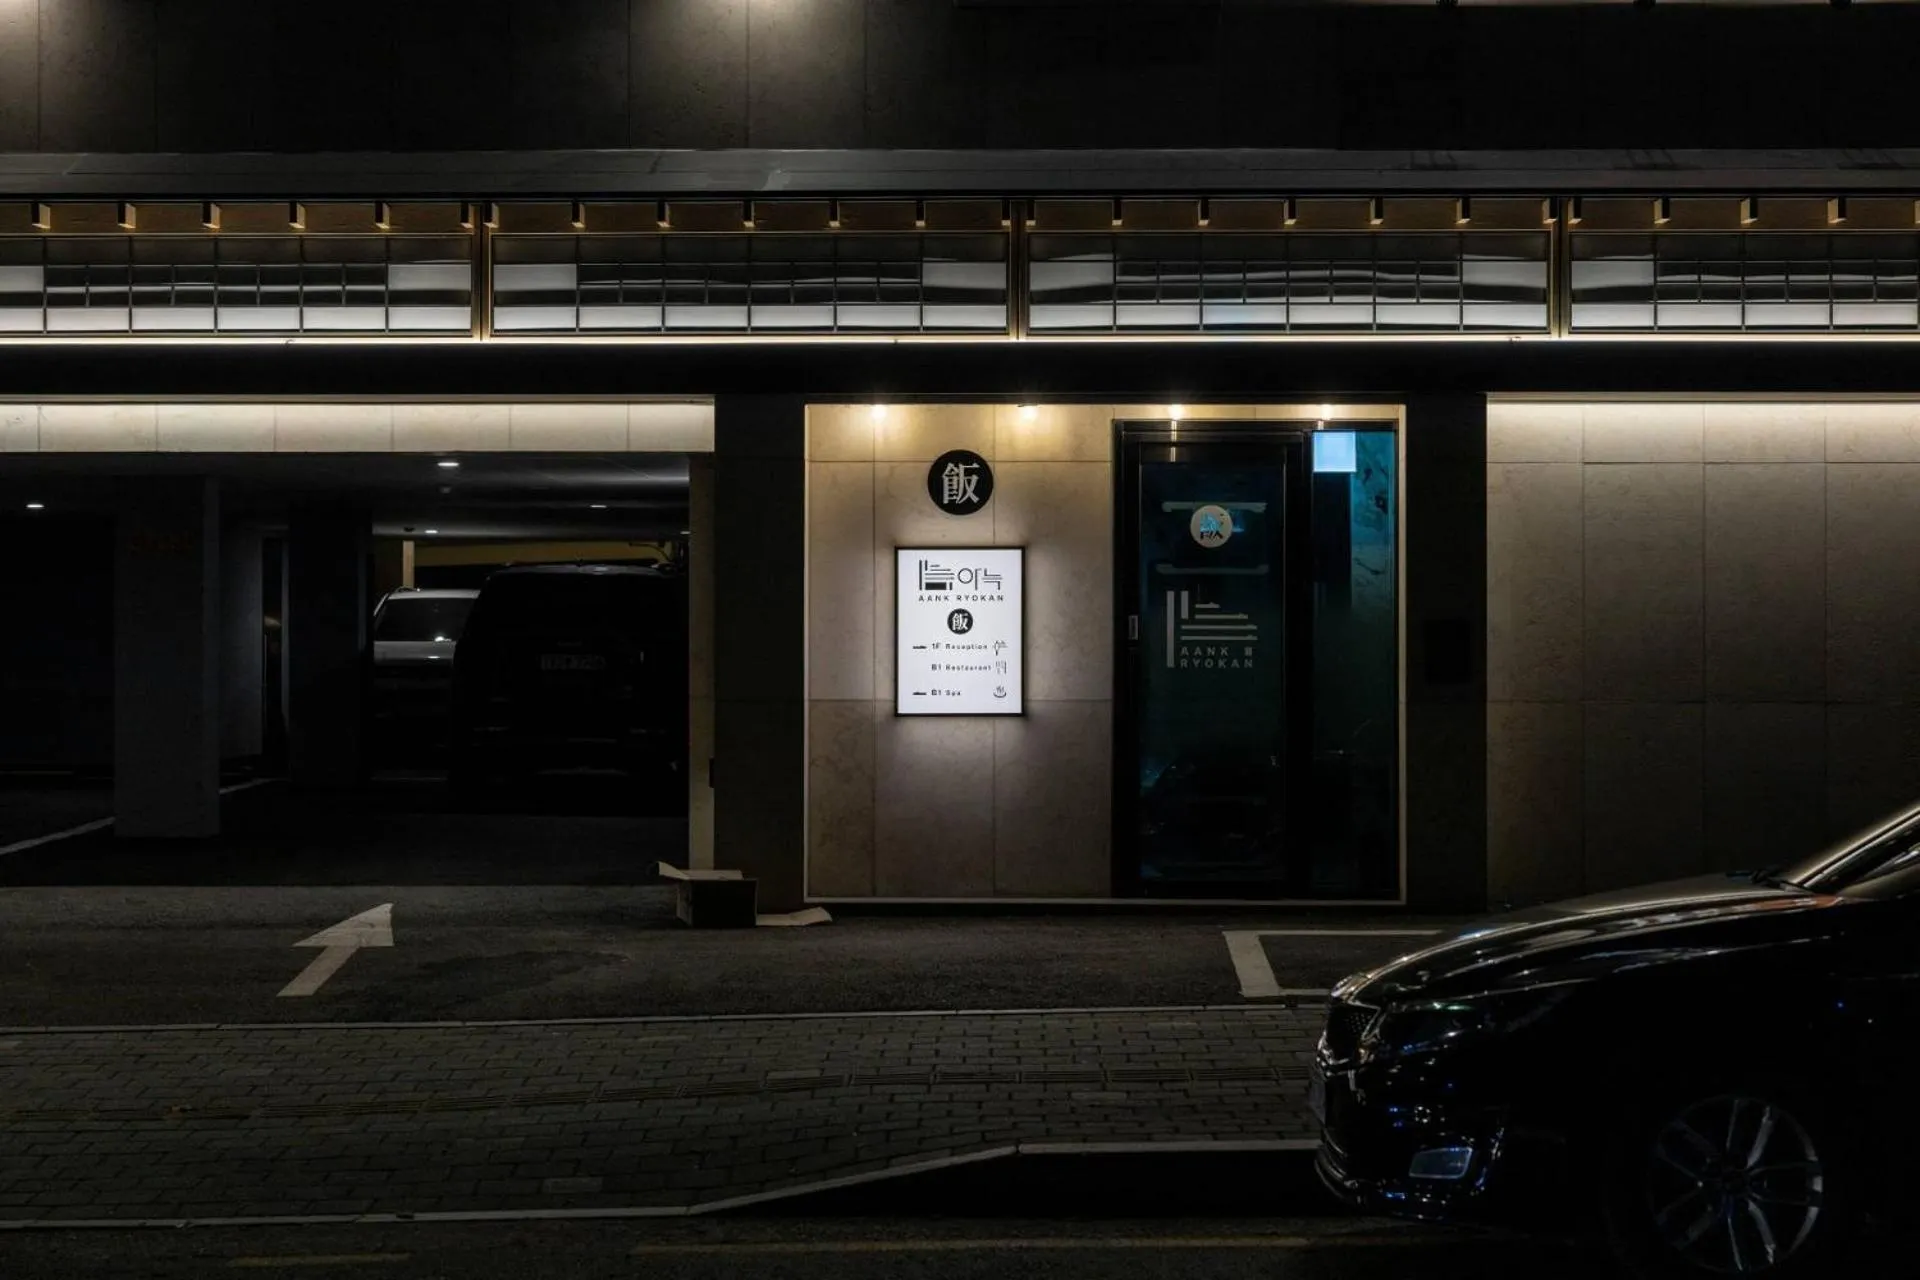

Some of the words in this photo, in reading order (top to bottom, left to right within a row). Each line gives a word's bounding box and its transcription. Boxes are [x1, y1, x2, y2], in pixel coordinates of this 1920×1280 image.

[942, 462, 980, 504] 飯
[919, 594, 949, 602] AANK
[956, 594, 1004, 602] RYOKAN
[952, 612, 969, 631] 飯
[1179, 646, 1229, 656] AANK
[945, 663, 992, 671] Restaurant
[1179, 658, 1253, 669] RYOKAN
